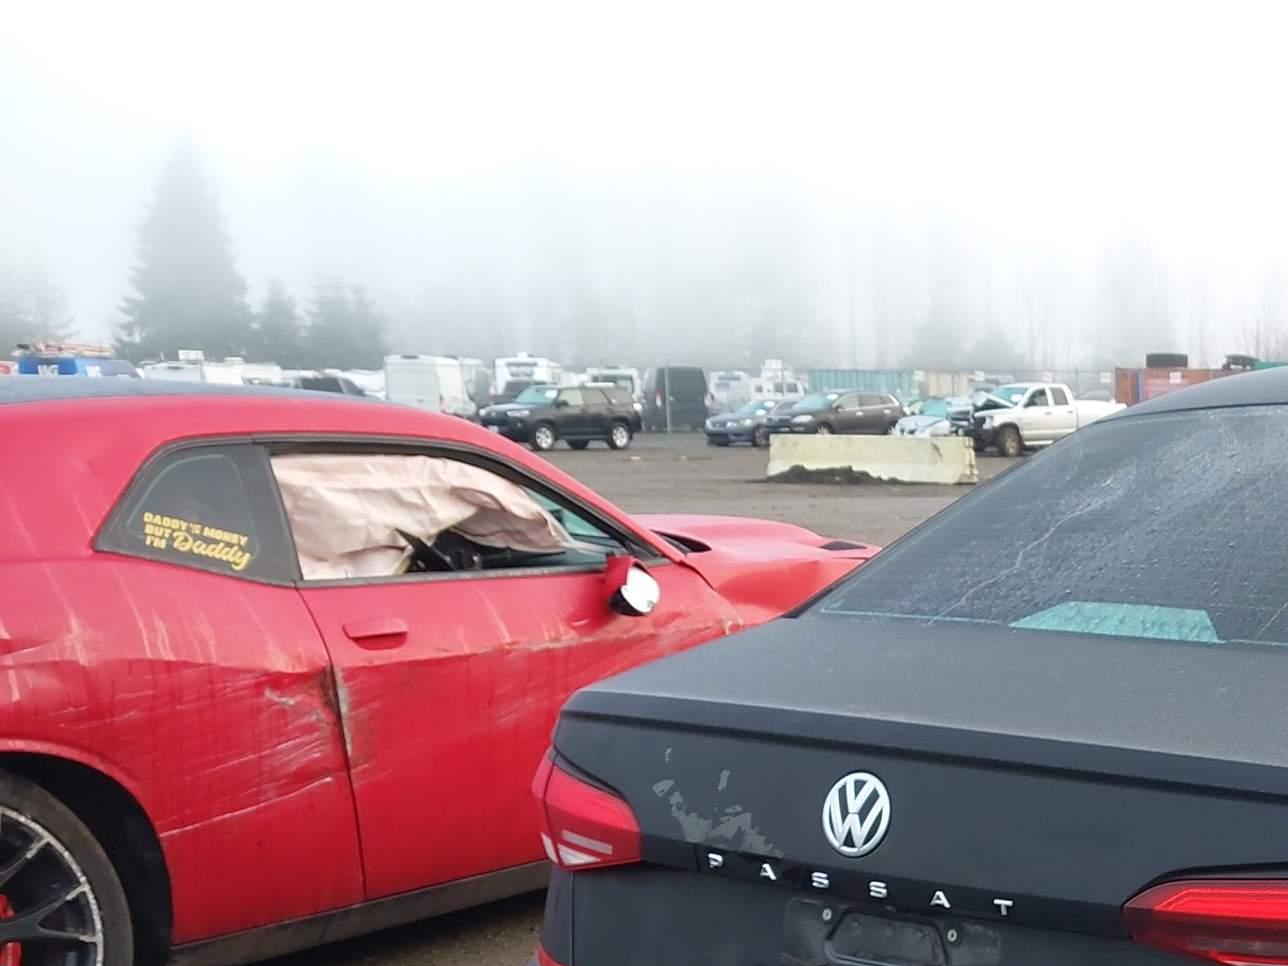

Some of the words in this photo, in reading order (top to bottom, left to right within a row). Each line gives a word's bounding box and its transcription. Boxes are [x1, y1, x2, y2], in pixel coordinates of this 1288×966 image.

[144, 523, 172, 538] BUT
[172, 531, 251, 571] Daddy
[822, 771, 891, 857] VW
[707, 853, 1014, 916] PASSAT
